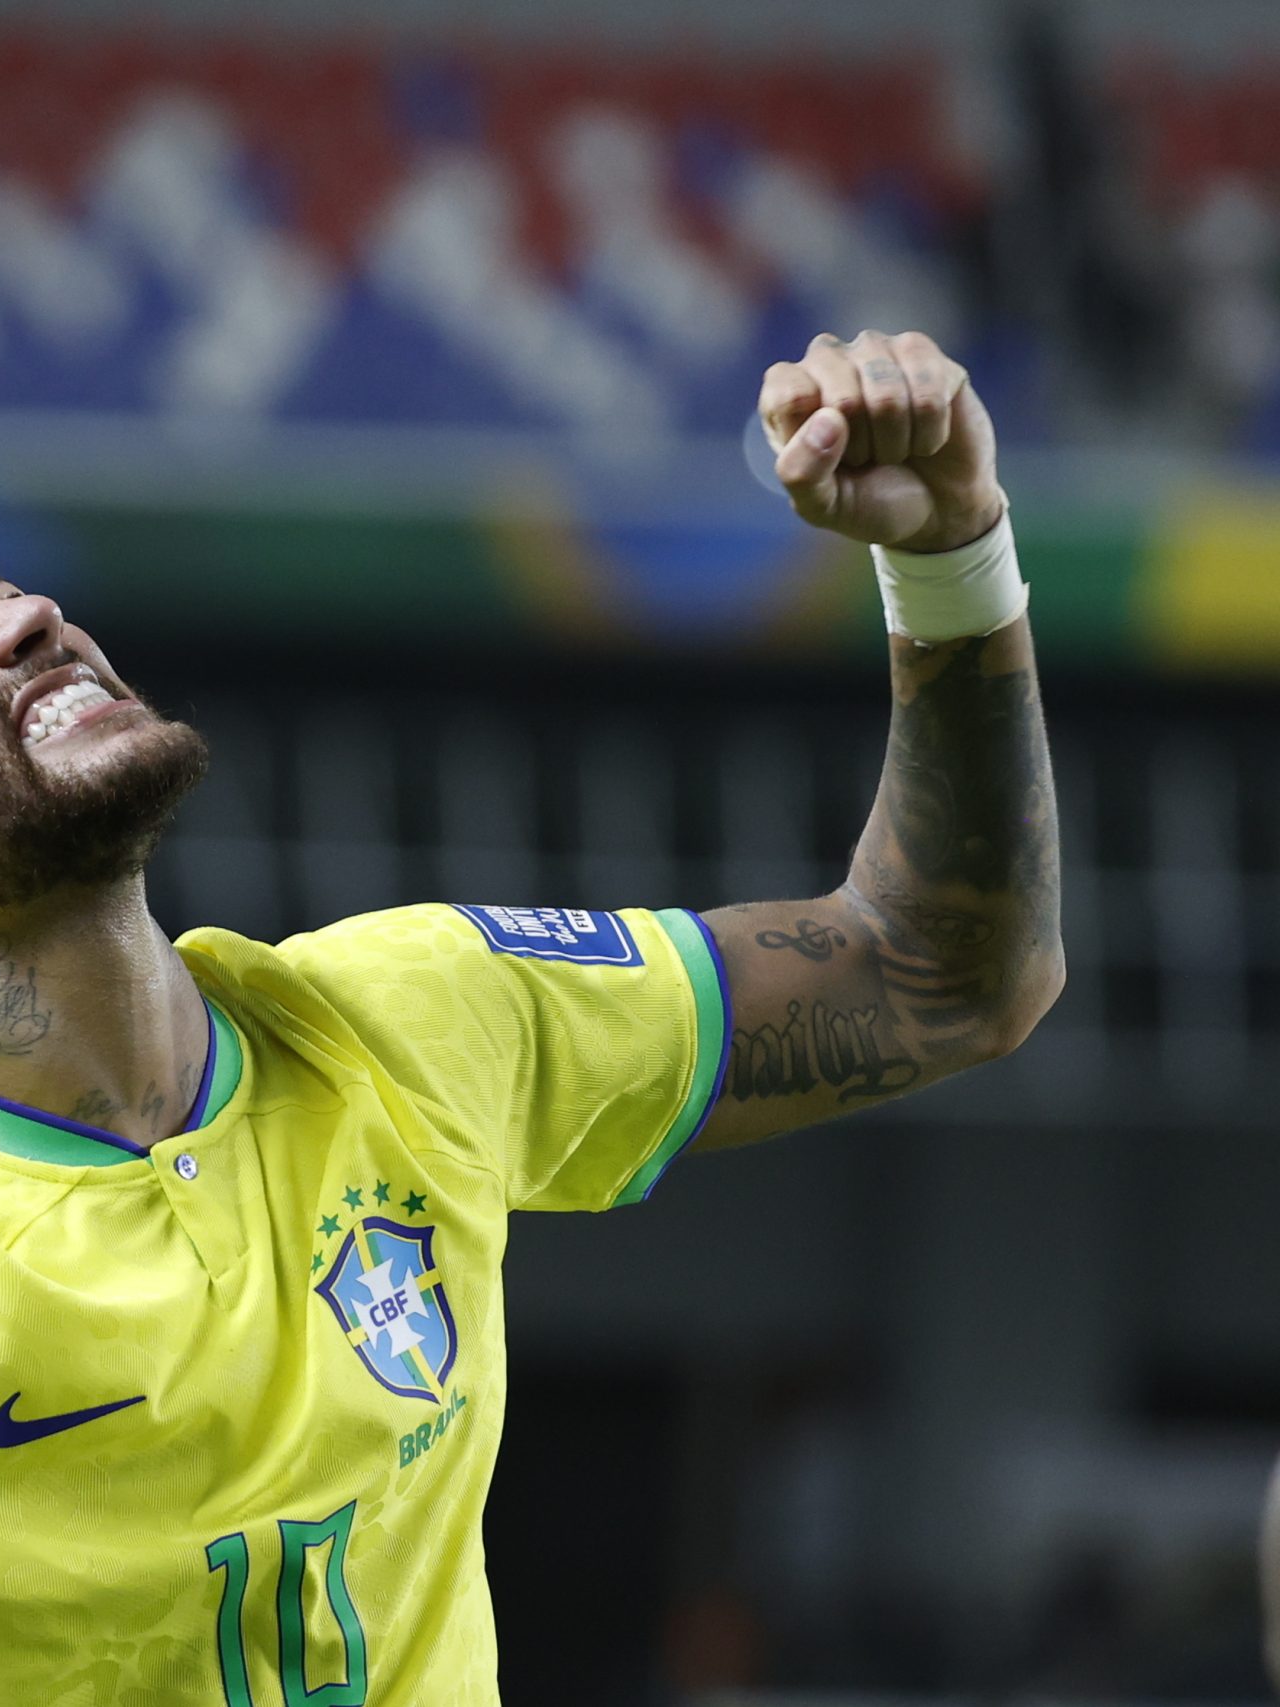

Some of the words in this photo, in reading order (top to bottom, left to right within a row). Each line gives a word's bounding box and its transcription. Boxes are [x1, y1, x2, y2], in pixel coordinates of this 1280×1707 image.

[507, 906, 551, 938] UNIT
[571, 909, 589, 929] FIF
[369, 1289, 409, 1328] CBF
[204, 1498, 367, 1707] 10
